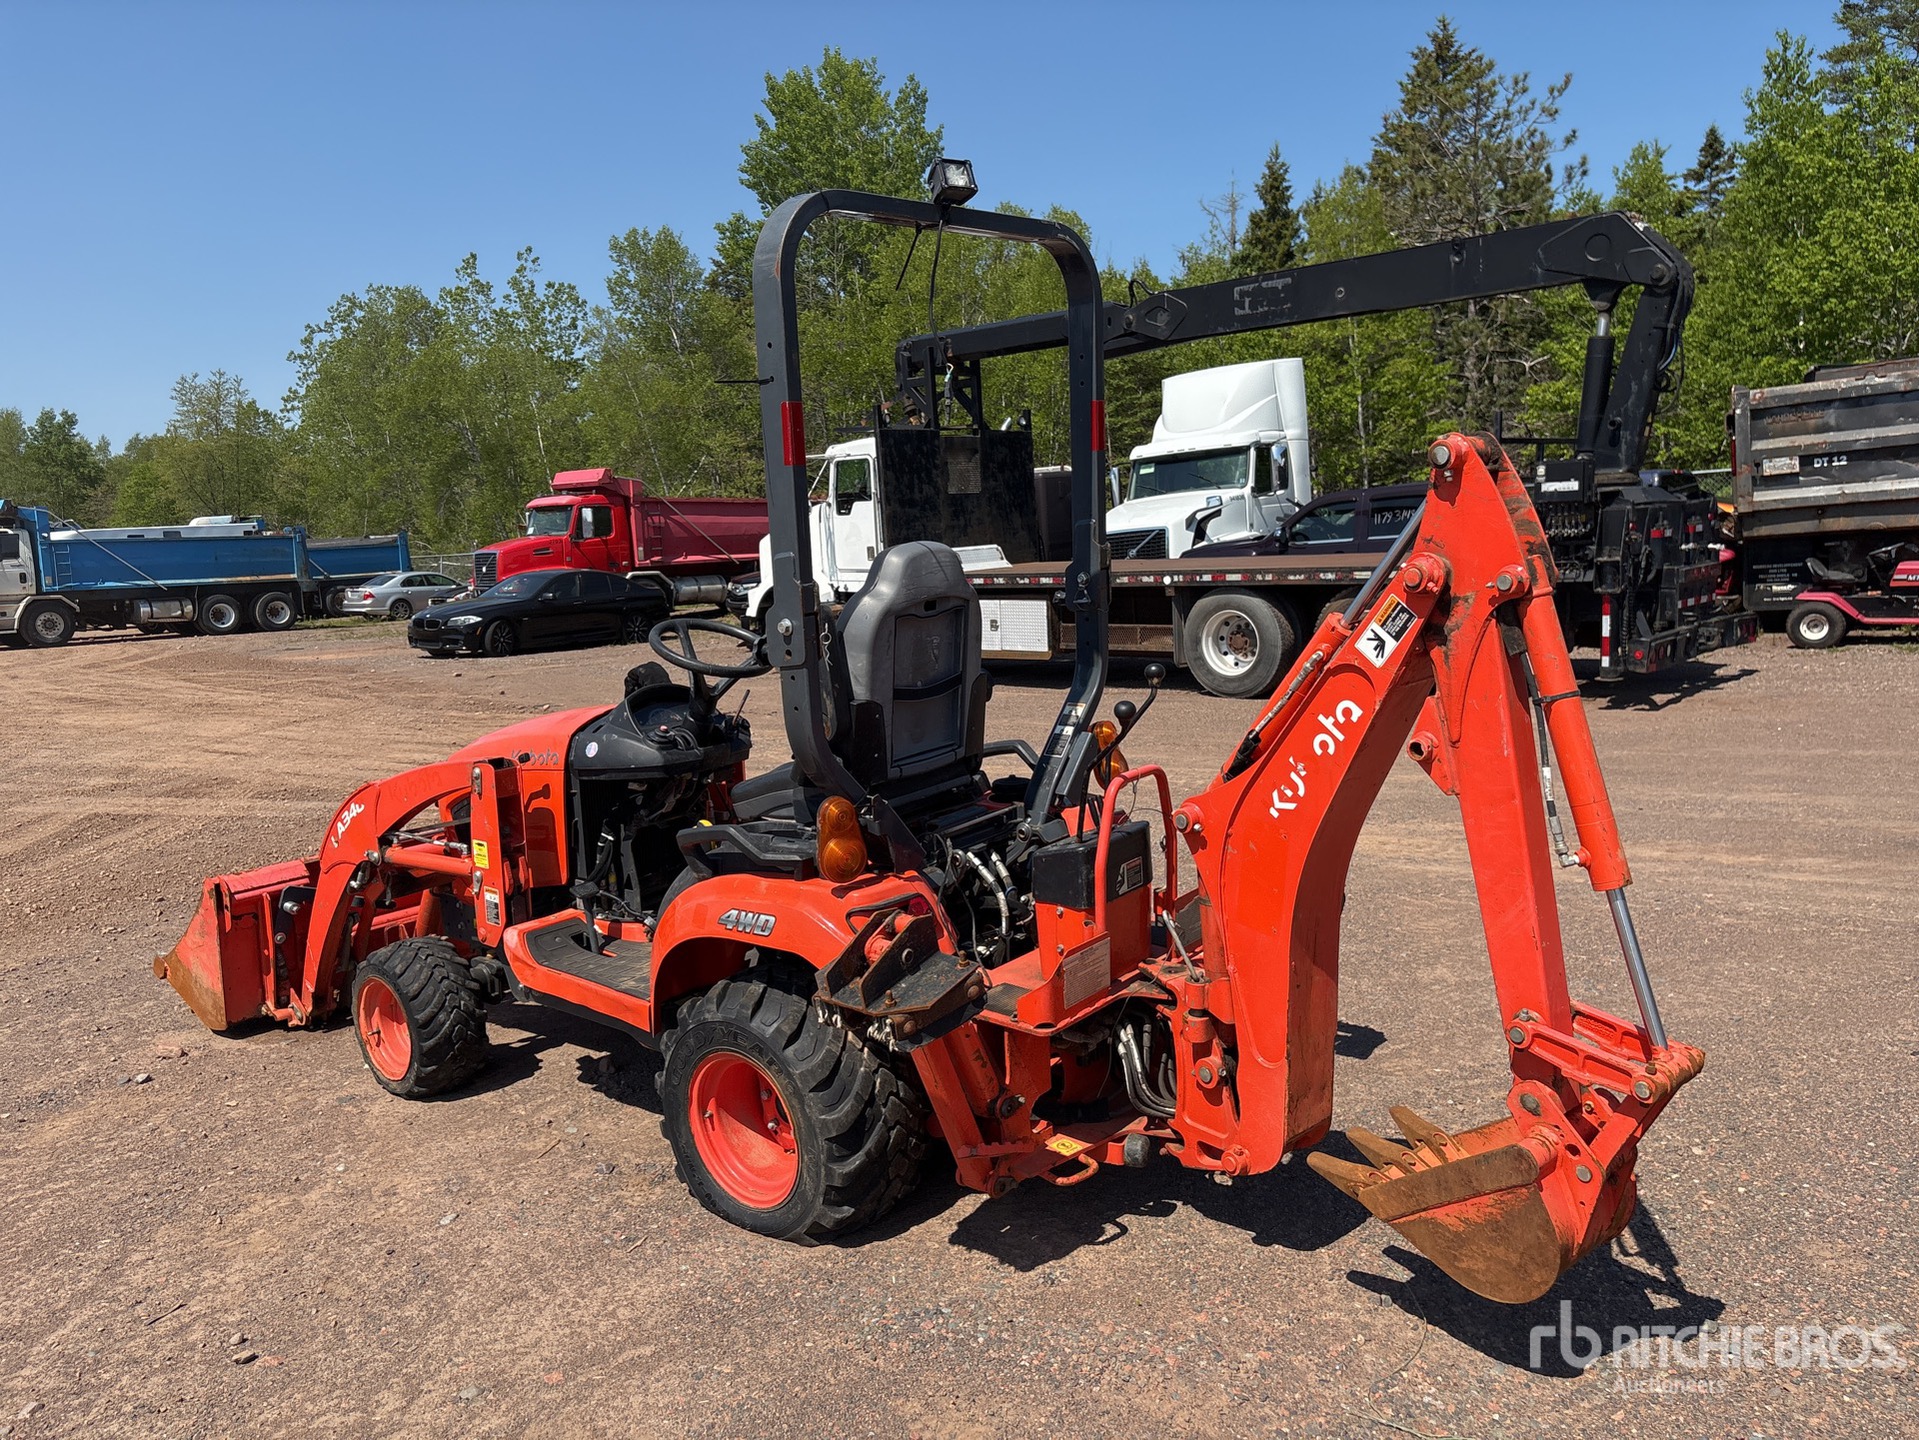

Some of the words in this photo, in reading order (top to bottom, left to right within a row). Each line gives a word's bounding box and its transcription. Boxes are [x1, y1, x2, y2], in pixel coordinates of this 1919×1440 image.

[1813, 457, 1829, 468] DT
[1831, 455, 1848, 466] 12
[511, 747, 560, 766] Kbota
[717, 908, 777, 937] 4WD
